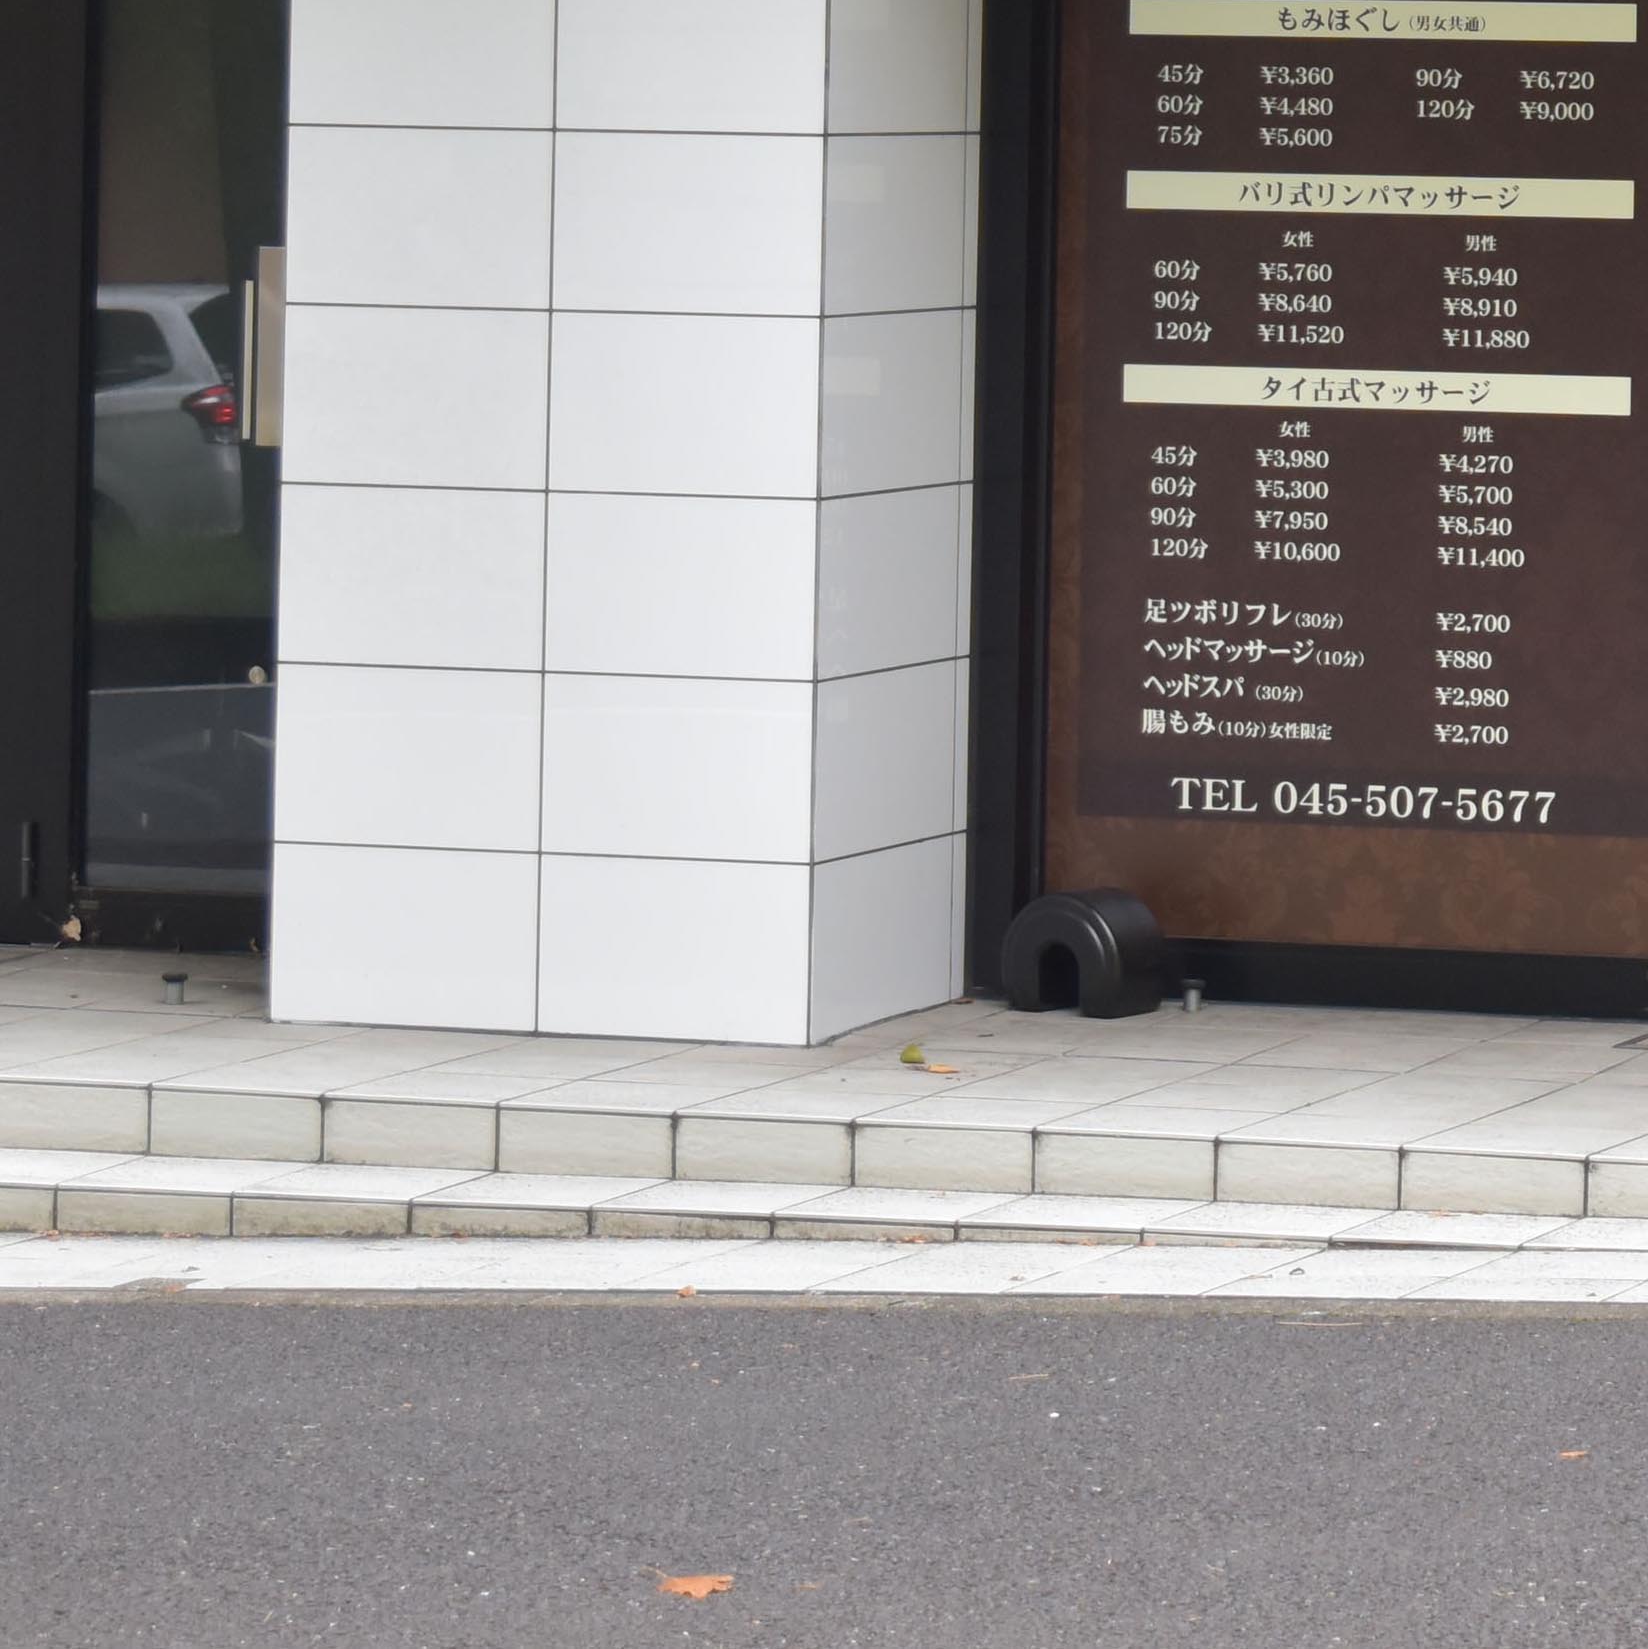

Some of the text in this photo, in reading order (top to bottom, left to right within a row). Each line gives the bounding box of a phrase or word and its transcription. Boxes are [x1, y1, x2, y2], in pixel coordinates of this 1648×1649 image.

[1277, 7, 1400, 31] もみほぐし
[1157, 64, 1334, 87] 45分 ¥3,360
[1416, 68, 1594, 91] 90分 ¥6,720
[1157, 95, 1333, 118] 60分 ¥4,480
[1416, 100, 1594, 122] 120分 ¥9,000
[1157, 126, 1333, 148] 75分 ¥5,600
[1239, 182, 1520, 210] バリ式リンパマッサージ
[1282, 230, 1314, 248] 女性
[1465, 234, 1496, 252] 男性
[1154, 260, 1517, 287] 60分 ¥5,760 ¥5,940
[1154, 291, 1517, 318] 90分 ¥8,640 ¥8,910
[1154, 321, 1530, 349] 120分 ¥11,520 ¥11,880
[1261, 376, 1491, 406] タイ古式マッサージ
[1279, 421, 1311, 438] 女性
[1463, 426, 1494, 443] 男性
[1151, 446, 1513, 474] 45分 ¥3,980 ¥4,270
[1151, 477, 1513, 506] 60分 ¥5,300 ¥5,700
[1150, 508, 1512, 537] 90分 ¥7,950 ¥8,540
[1151, 538, 1525, 569] 120分 ¥10,600 ¥11,400
[1144, 599, 1292, 627] 足ツボリフレ
[1437, 613, 1510, 634] ¥2,700
[1144, 638, 1314, 664] ヘッドマッサージ
[1436, 650, 1492, 670] ¥880
[1143, 674, 1244, 698] ヘッドスパ
[1436, 687, 1509, 709] ¥2,980
[1142, 710, 1215, 735] 腸もみ
[1269, 723, 1332, 741] 女性限定
[1435, 724, 1509, 746] ¥2,700
[1172, 778, 1557, 824] TEL 045-507-5677
